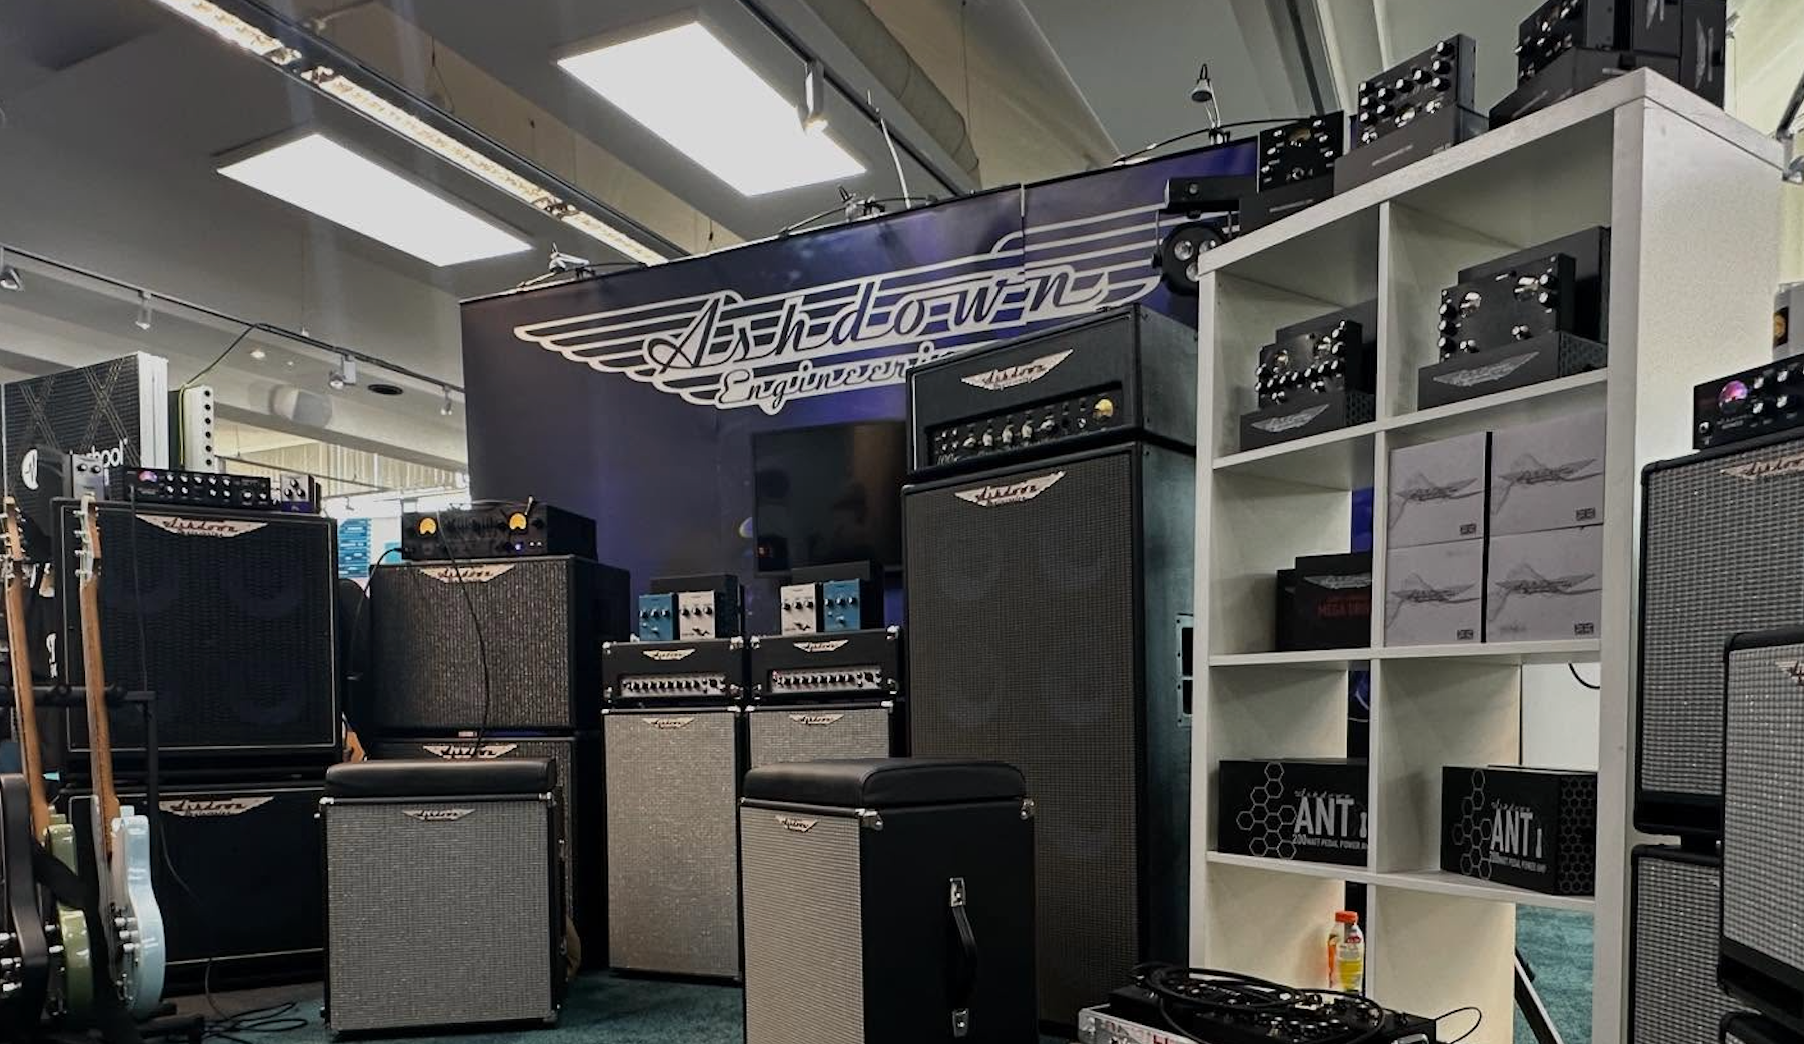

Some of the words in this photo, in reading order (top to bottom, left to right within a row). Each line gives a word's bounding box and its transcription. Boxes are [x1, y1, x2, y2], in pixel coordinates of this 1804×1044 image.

[646, 267, 1106, 374] Ashdown
[718, 344, 955, 409] Engineeri
[1294, 796, 1355, 837] ANT
[1490, 808, 1534, 857] ANT
